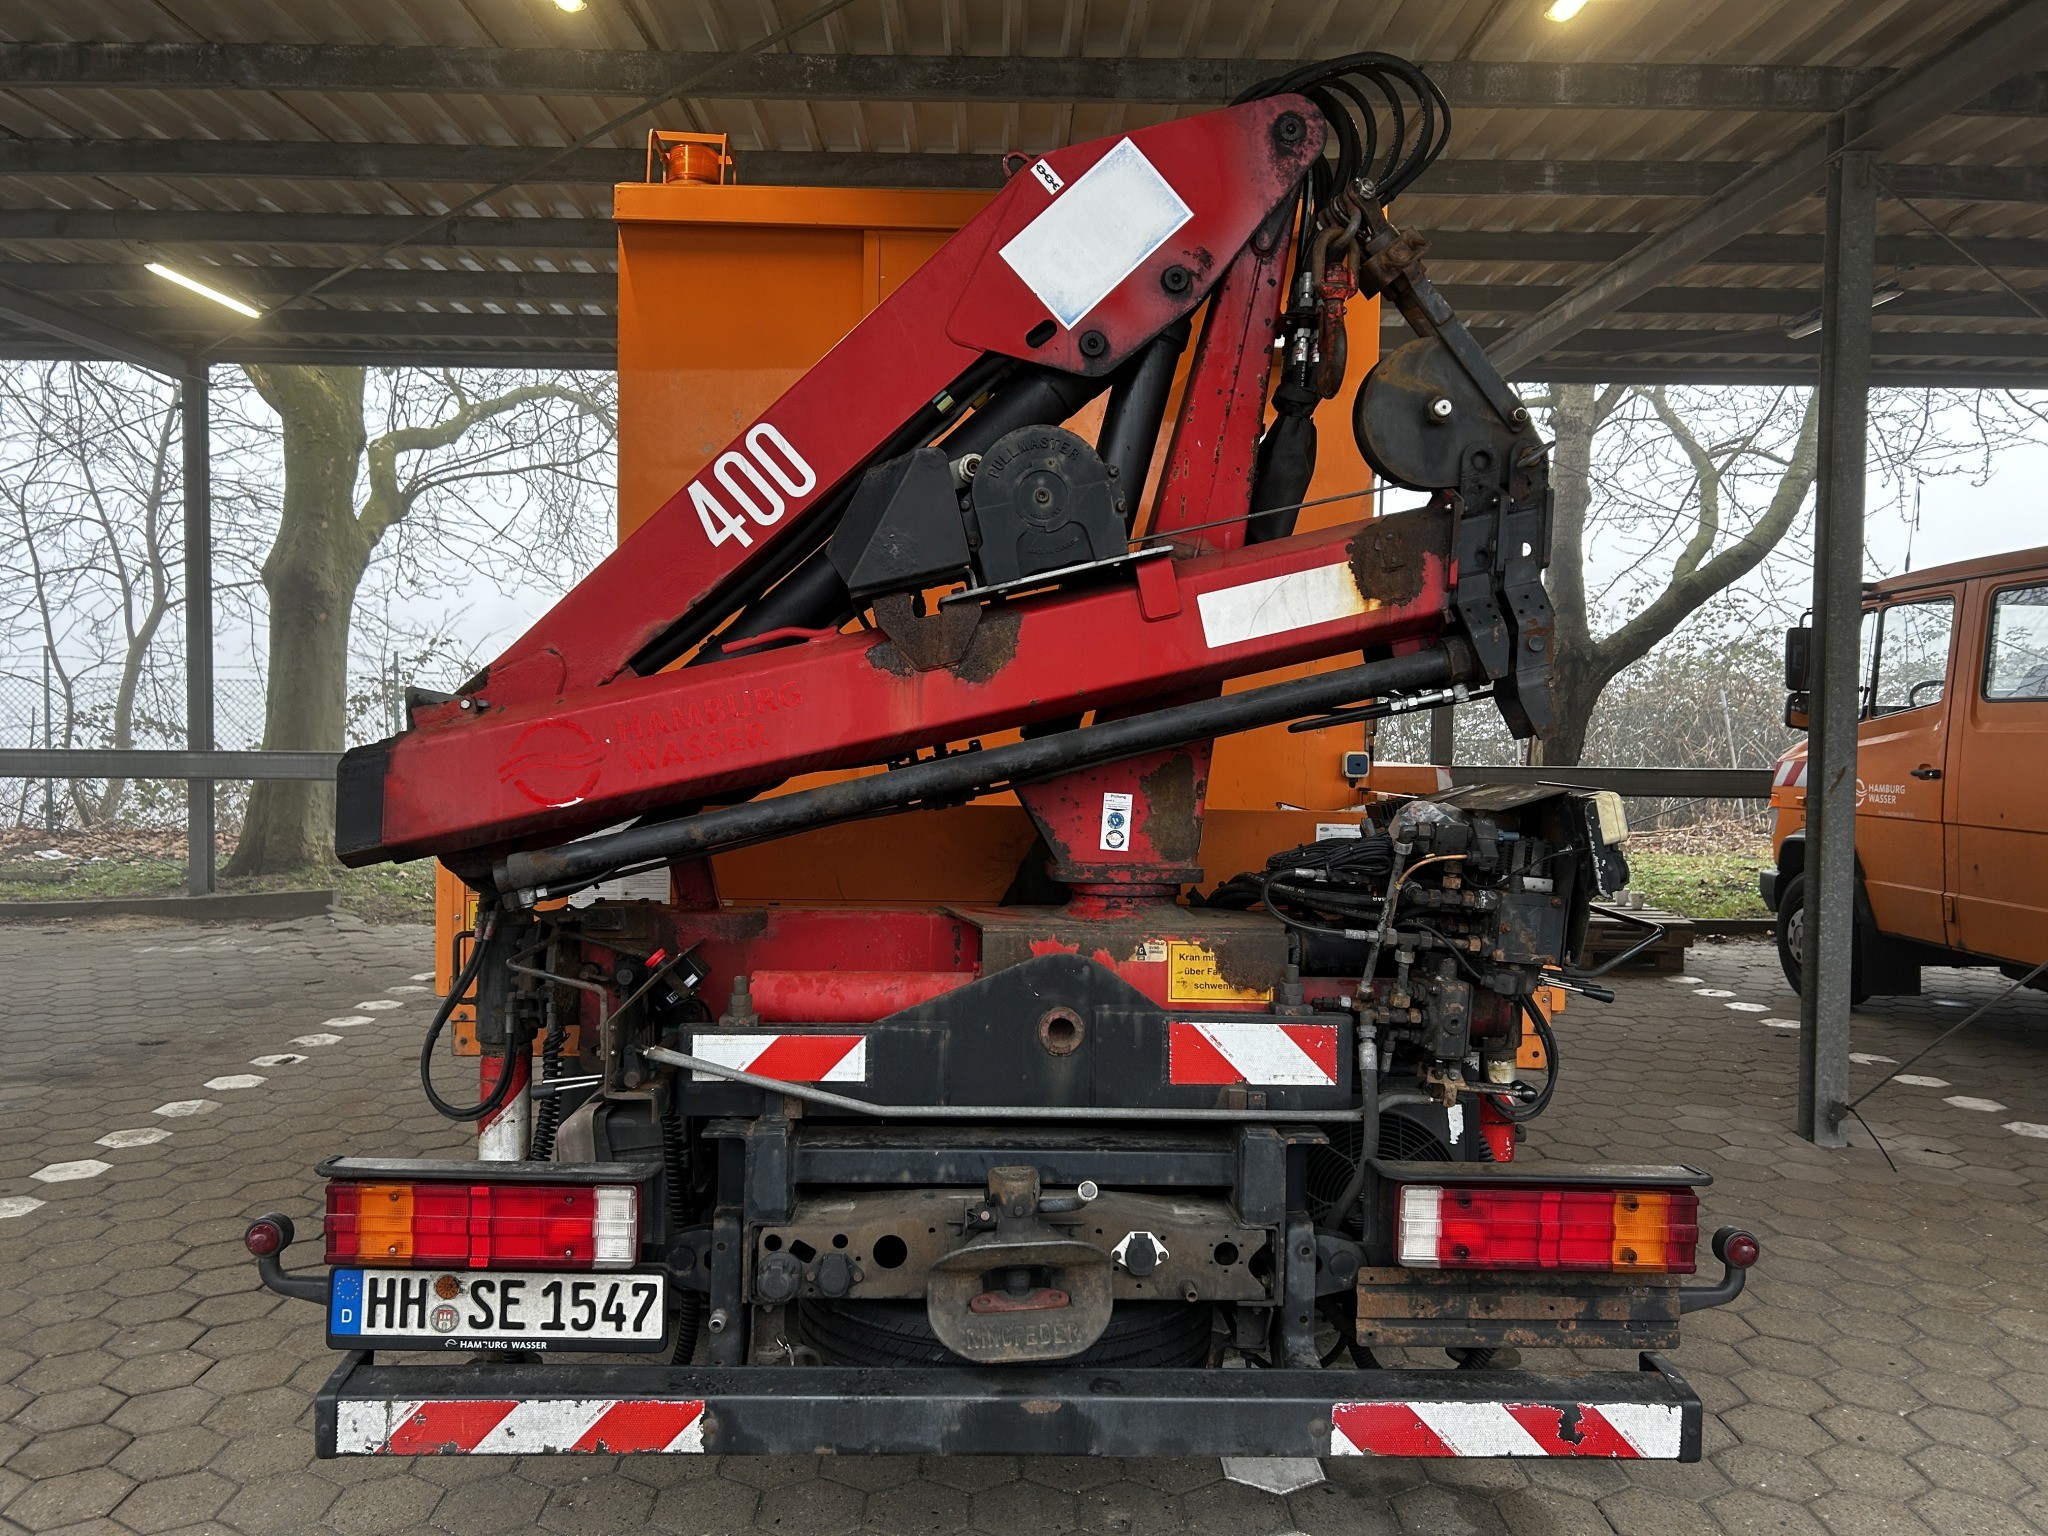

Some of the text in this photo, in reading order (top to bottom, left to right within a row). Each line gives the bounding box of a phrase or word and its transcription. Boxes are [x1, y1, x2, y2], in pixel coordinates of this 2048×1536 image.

[987, 437, 1080, 479] PULLMASTER
[688, 422, 817, 548] 400
[616, 680, 803, 743] HAMBURG
[625, 722, 770, 774] WASSER
[1868, 784, 1906, 794] HAMBURG
[1868, 794, 1896, 804] WASSER
[1178, 952, 1216, 962] Kran mi
[1184, 966, 1221, 976] über Fa
[1194, 982, 1235, 990] schwenk
[341, 1277, 658, 1332] D HH SE 1547
[511, 1341, 548, 1350] WASSER
[965, 1322, 1081, 1350] RINGFEDER
